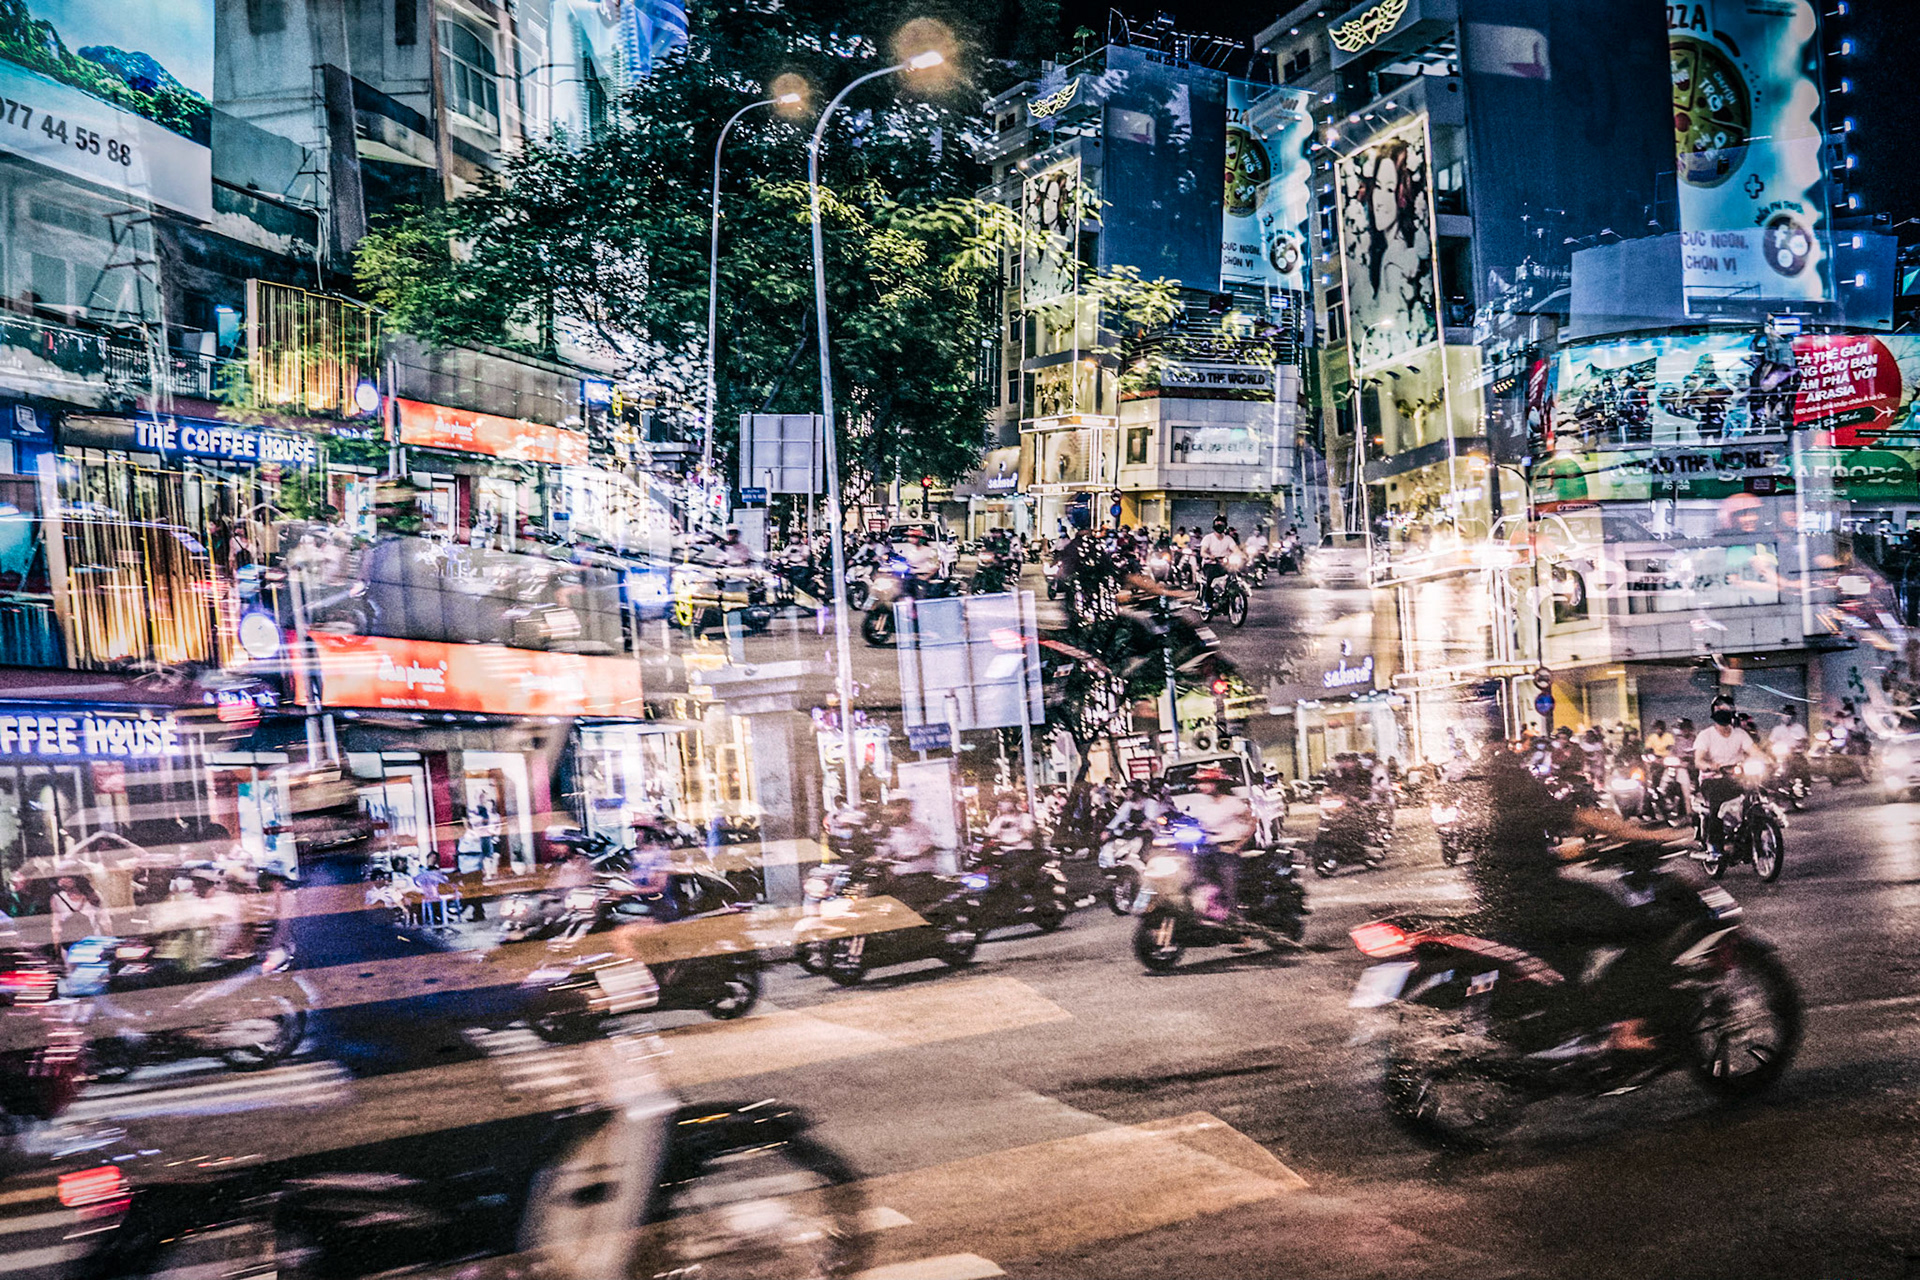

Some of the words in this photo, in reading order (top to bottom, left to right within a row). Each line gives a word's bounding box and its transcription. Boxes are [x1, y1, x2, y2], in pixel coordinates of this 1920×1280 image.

[41, 114, 68, 144] 44
[75, 126, 101, 155] 55
[107, 139, 131, 167] 88
[1685, 255, 1718, 275] CHỌN
[1208, 373, 1226, 384] THE
[1228, 373, 1265, 385] WORLD
[1805, 384, 1856, 403] AIRASIA
[136, 422, 178, 449] THE
[181, 428, 257, 458] COFFEE
[259, 434, 316, 463] HOUSE
[83, 717, 181, 756] HOUSE
